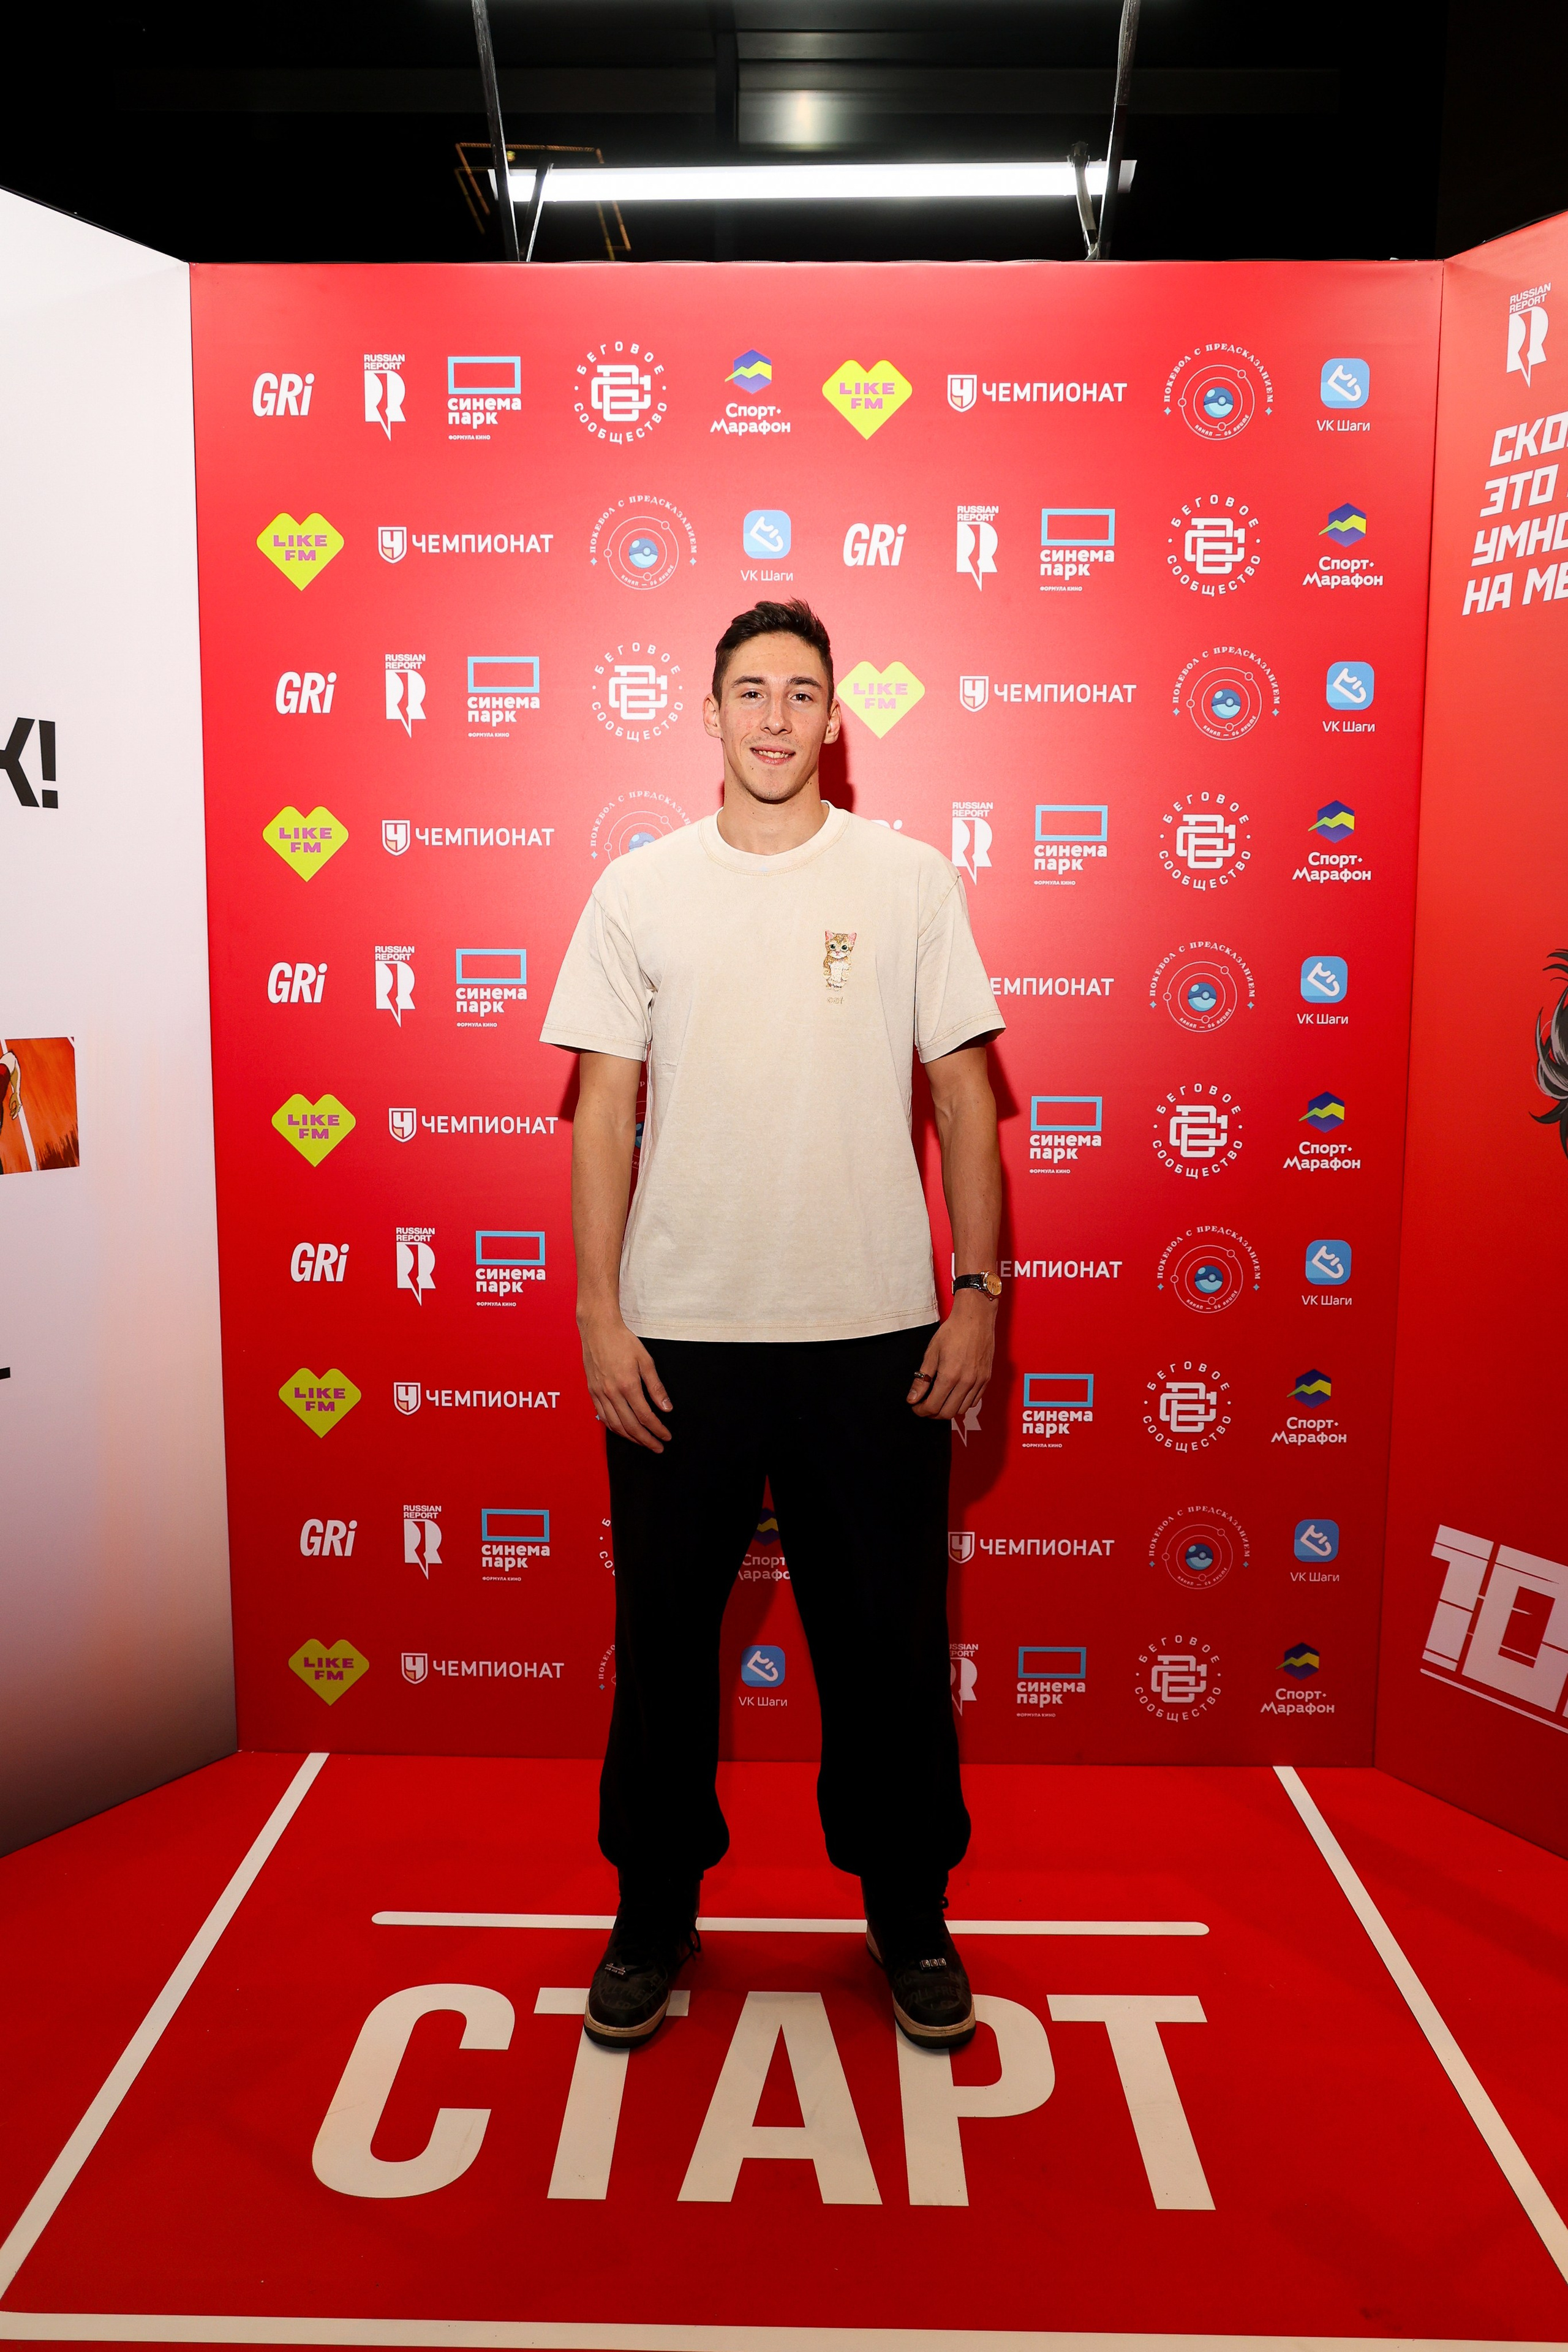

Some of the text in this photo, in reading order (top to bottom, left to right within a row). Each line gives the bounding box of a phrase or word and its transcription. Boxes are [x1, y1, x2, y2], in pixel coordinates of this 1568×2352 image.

[1509, 282, 1551, 305] RUSSIAN
[1509, 292, 1547, 314] REPORT
[363, 353, 405, 363] RUSSIAN
[363, 361, 402, 371] REPORT
[576, 341, 665, 375] БЕГОВОЕ
[839, 382, 895, 395] LIKE
[982, 382, 1128, 402] ЧЕМПИОНАТ
[447, 397, 522, 411] синема
[851, 398, 883, 410] FM
[448, 412, 498, 429] парк
[574, 402, 667, 445] СООБЩЕСТВО
[710, 418, 791, 436] Марафон
[1316, 420, 1370, 431] VK Шаги
[1489, 410, 1568, 467] СКО
[1479, 463, 1559, 518] ЭТО
[956, 505, 998, 514] RUSSIAN
[956, 513, 995, 522] REPORT
[1170, 494, 1259, 528] БЕГОВОЕ
[273, 534, 327, 547] LIKE
[412, 533, 554, 553] ЧЕМПИОНАТ
[284, 549, 316, 561] FM
[1039, 549, 1115, 562] синема
[740, 570, 794, 581] VK Шаги
[1040, 563, 1091, 581] парк
[1167, 555, 1261, 597] СООБЩЕСТВО
[1302, 571, 1384, 589] Марафон
[1461, 572, 1513, 616] НА
[385, 654, 426, 662] RUSSIAN
[385, 662, 423, 670] REPORT
[594, 642, 681, 675] БЕГОВОЕ
[853, 682, 908, 695] LIKE
[993, 684, 1137, 703] ЧЕМПИОНАТ
[467, 696, 540, 709] синема
[864, 697, 897, 710] FM
[467, 710, 517, 727] парк
[592, 701, 684, 743] СООБЩЕСТВО
[1322, 720, 1375, 733] VK Шаги
[628, 790, 691, 825] ПРЕДСКАЗАН
[952, 801, 993, 810] RUSSIAN
[1162, 791, 1250, 824] БЕГОВОЕ
[279, 827, 332, 840] LIKE
[415, 827, 555, 846] ЧЕМПИОНАТ
[290, 842, 321, 854] FM
[1033, 844, 1107, 858] синема
[1034, 858, 1084, 875] парк
[1159, 850, 1251, 891] СООБЩЕСТВО
[1292, 866, 1371, 884] Марафон
[374, 945, 415, 954] RUSSIAN
[374, 952, 412, 961] REPORT
[455, 987, 527, 1000] синема
[989, 977, 1115, 996] ЕМПИОНАТ
[456, 1000, 505, 1017] парк
[1296, 1013, 1349, 1025] VK Шаги
[1156, 1083, 1242, 1115] БЕГОВОЕ
[287, 1114, 340, 1126] LIKE
[421, 1115, 559, 1134] ЧЕМПИОНАТ
[298, 1128, 329, 1140] FM
[1029, 1134, 1102, 1147] синема
[1030, 1147, 1079, 1164] парк
[1152, 1140, 1243, 1180] СООБЩЕСТВО
[1283, 1155, 1361, 1172] Марафон
[475, 1268, 546, 1281] синема
[1000, 1260, 1123, 1278] ЕМПИОНАТ
[476, 1281, 524, 1297] парк
[1301, 1295, 1352, 1305] VK Шаги
[1147, 1361, 1230, 1391] БЕГОВОЕ
[294, 1387, 345, 1400] LIKE
[426, 1390, 560, 1408] ЧЕМПИОНАТ
[305, 1401, 335, 1412] FM
[1022, 1410, 1093, 1422] синема
[1022, 1422, 1070, 1438] парк
[1143, 1415, 1231, 1453] СООБЩЕСТВО
[1270, 1430, 1347, 1446] Марафон
[481, 1544, 550, 1556] синема
[979, 1539, 1115, 1556] ЧЕМПИОНАТ
[482, 1556, 529, 1572] парк
[737, 1569, 791, 1582] арафо
[1290, 1572, 1340, 1582] VK Шаги
[1422, 1523, 1568, 1718] 10
[1138, 1635, 1220, 1664] БЕГОВОЕ
[303, 1657, 353, 1669] LIKE
[432, 1660, 565, 1678] ЧЕМПИОНАТ
[598, 1644, 616, 1680] ПОКЕБО
[314, 1670, 344, 1681] FM
[1017, 1681, 1086, 1693] синема
[738, 1696, 788, 1706] VK Шаги
[1017, 1694, 1063, 1708] парк
[1134, 1687, 1221, 1723] СООБЩЕСТВО
[1260, 1701, 1335, 1716] Марафон
[311, 1983, 1216, 2211] СТАРТ
